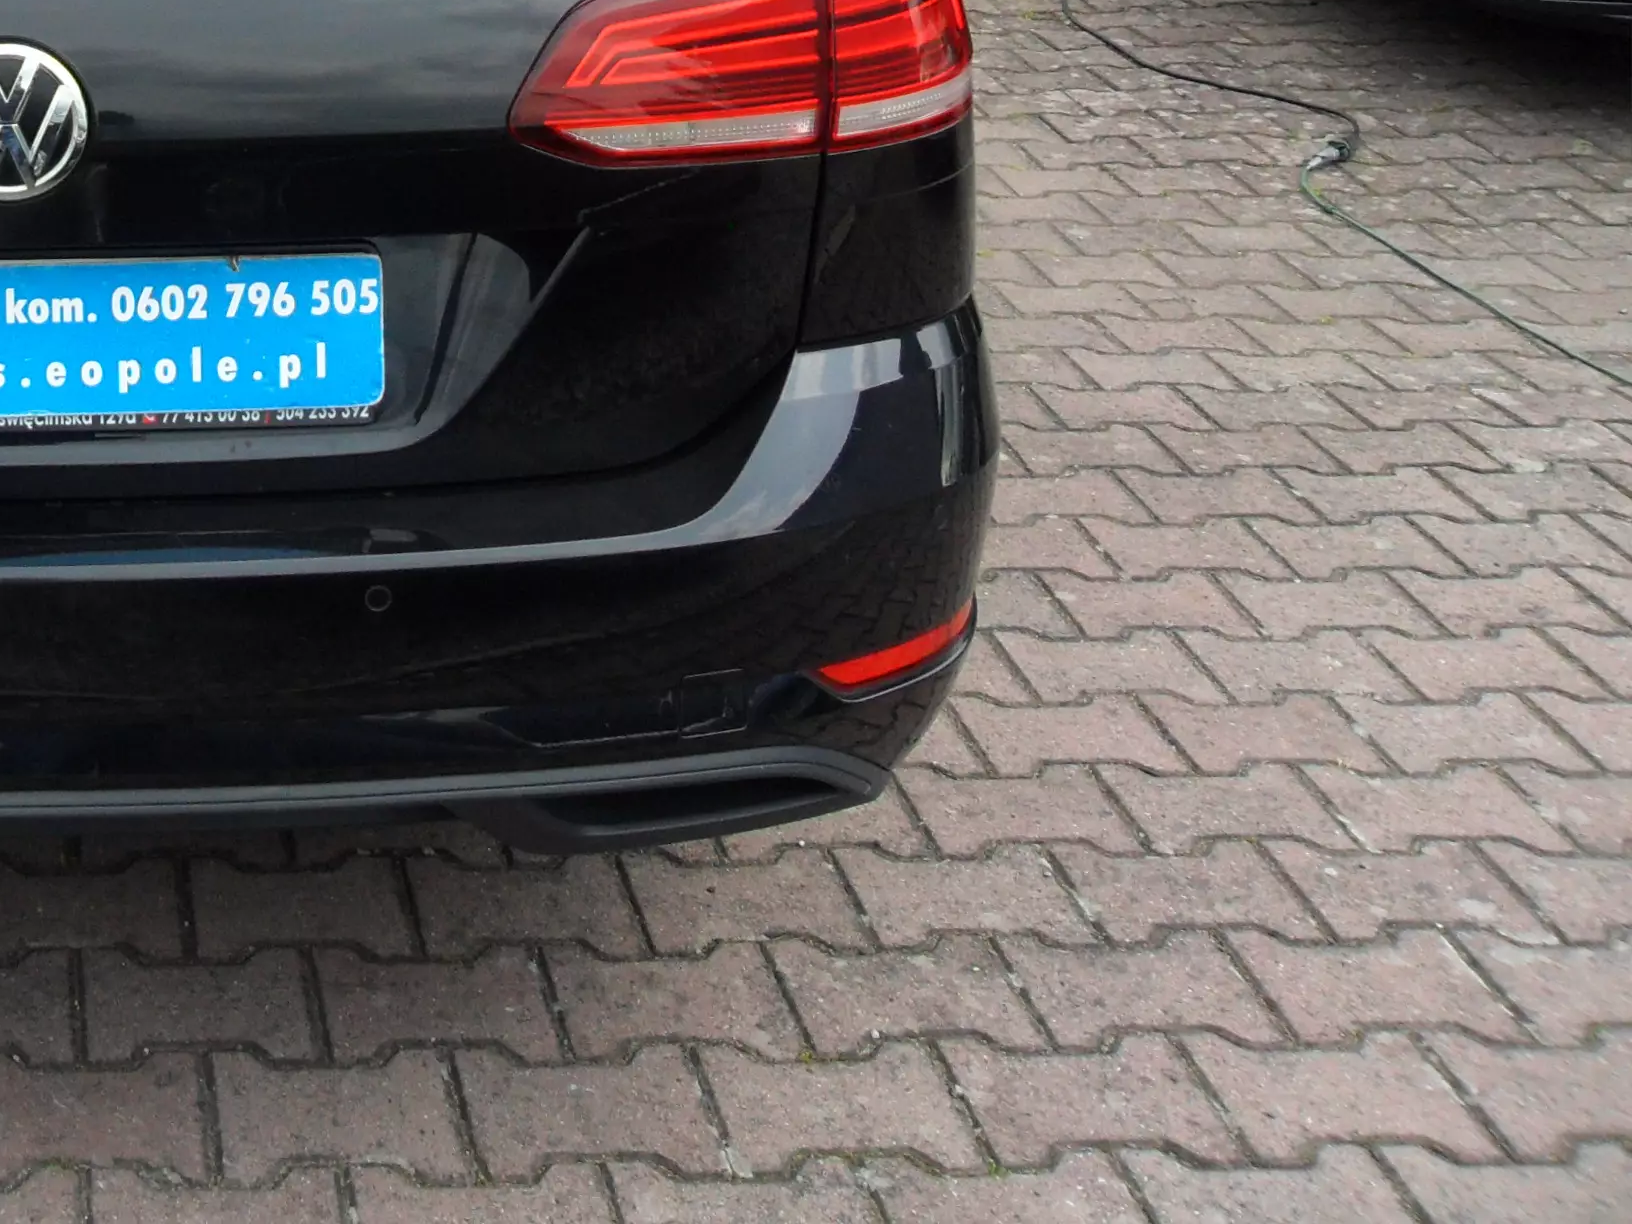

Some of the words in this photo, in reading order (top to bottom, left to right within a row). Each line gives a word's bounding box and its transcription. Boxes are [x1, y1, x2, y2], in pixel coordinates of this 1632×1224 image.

[5, 288, 97, 324] kom.
[112, 284, 208, 322] 0602
[225, 282, 296, 317] 796
[311, 279, 379, 316] 505
